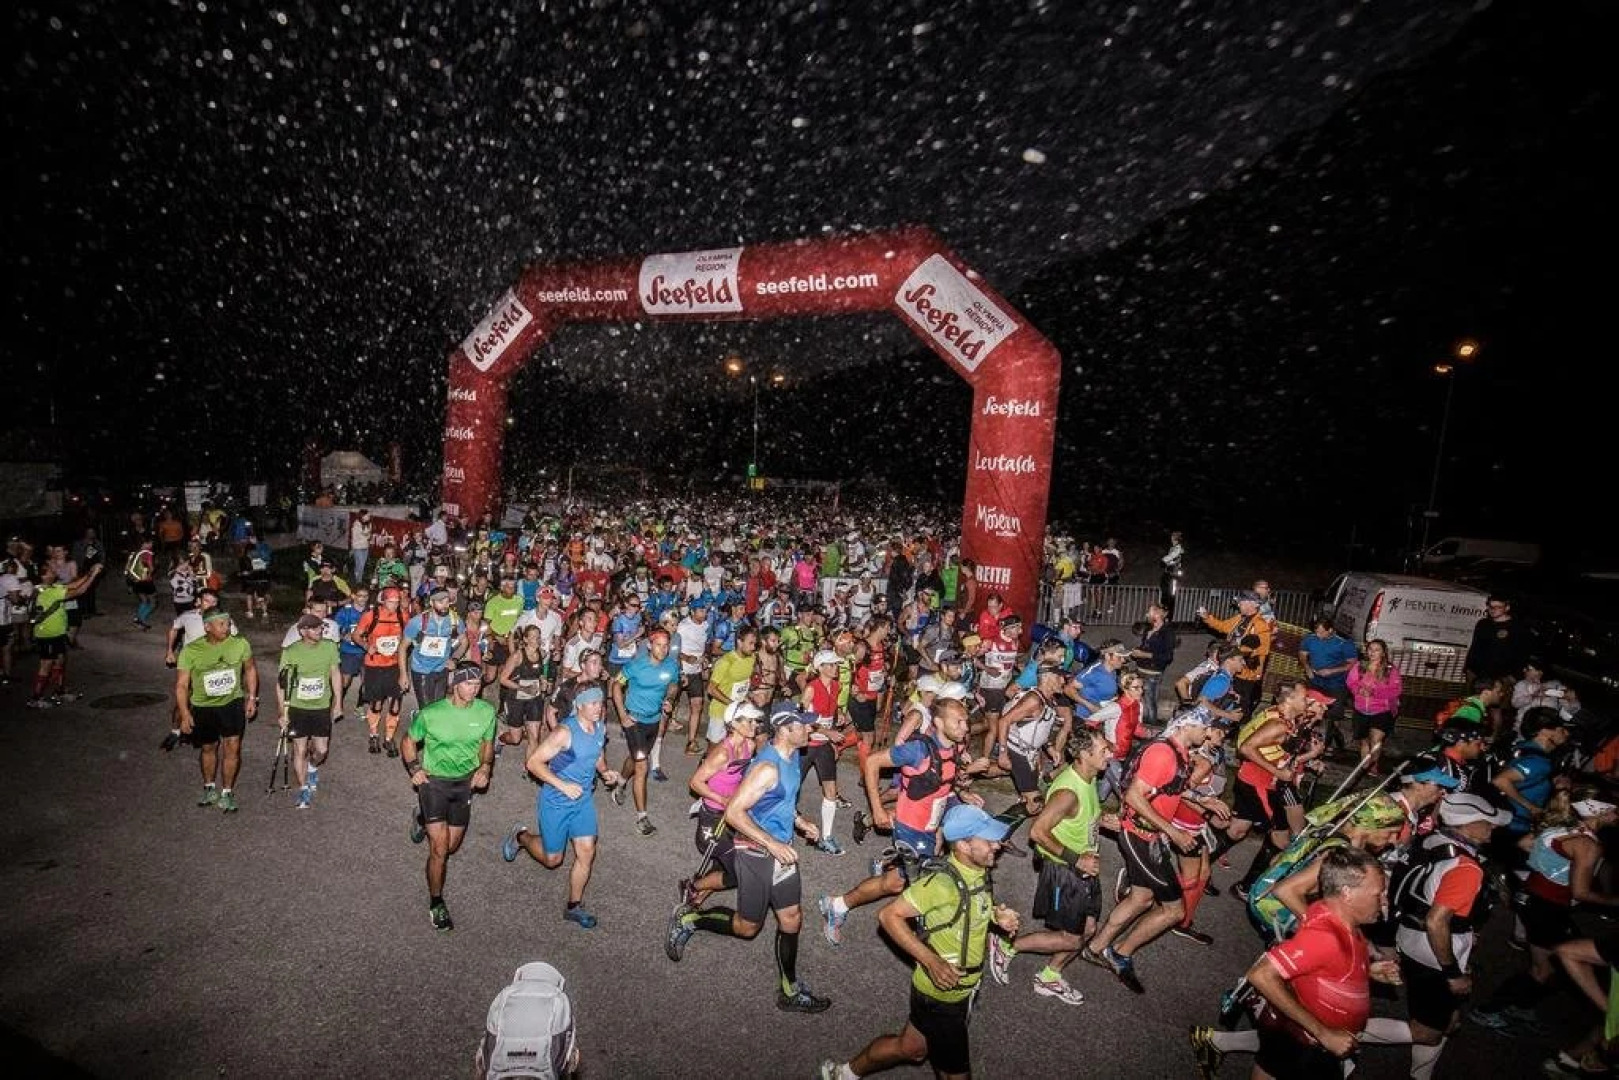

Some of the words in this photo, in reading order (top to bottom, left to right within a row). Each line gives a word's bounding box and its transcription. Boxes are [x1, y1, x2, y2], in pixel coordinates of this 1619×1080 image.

[695, 263, 727, 272] REGION
[646, 274, 733, 308] Seefeld
[756, 272, 878, 295] seefeld.com
[538, 288, 628, 303] seefeld.com
[474, 303, 524, 362] Seefeld
[905, 284, 985, 361] Seefeld
[982, 396, 1041, 417] Seefeld
[976, 565, 1012, 584] REITH
[1405, 600, 1446, 613] PENTEK
